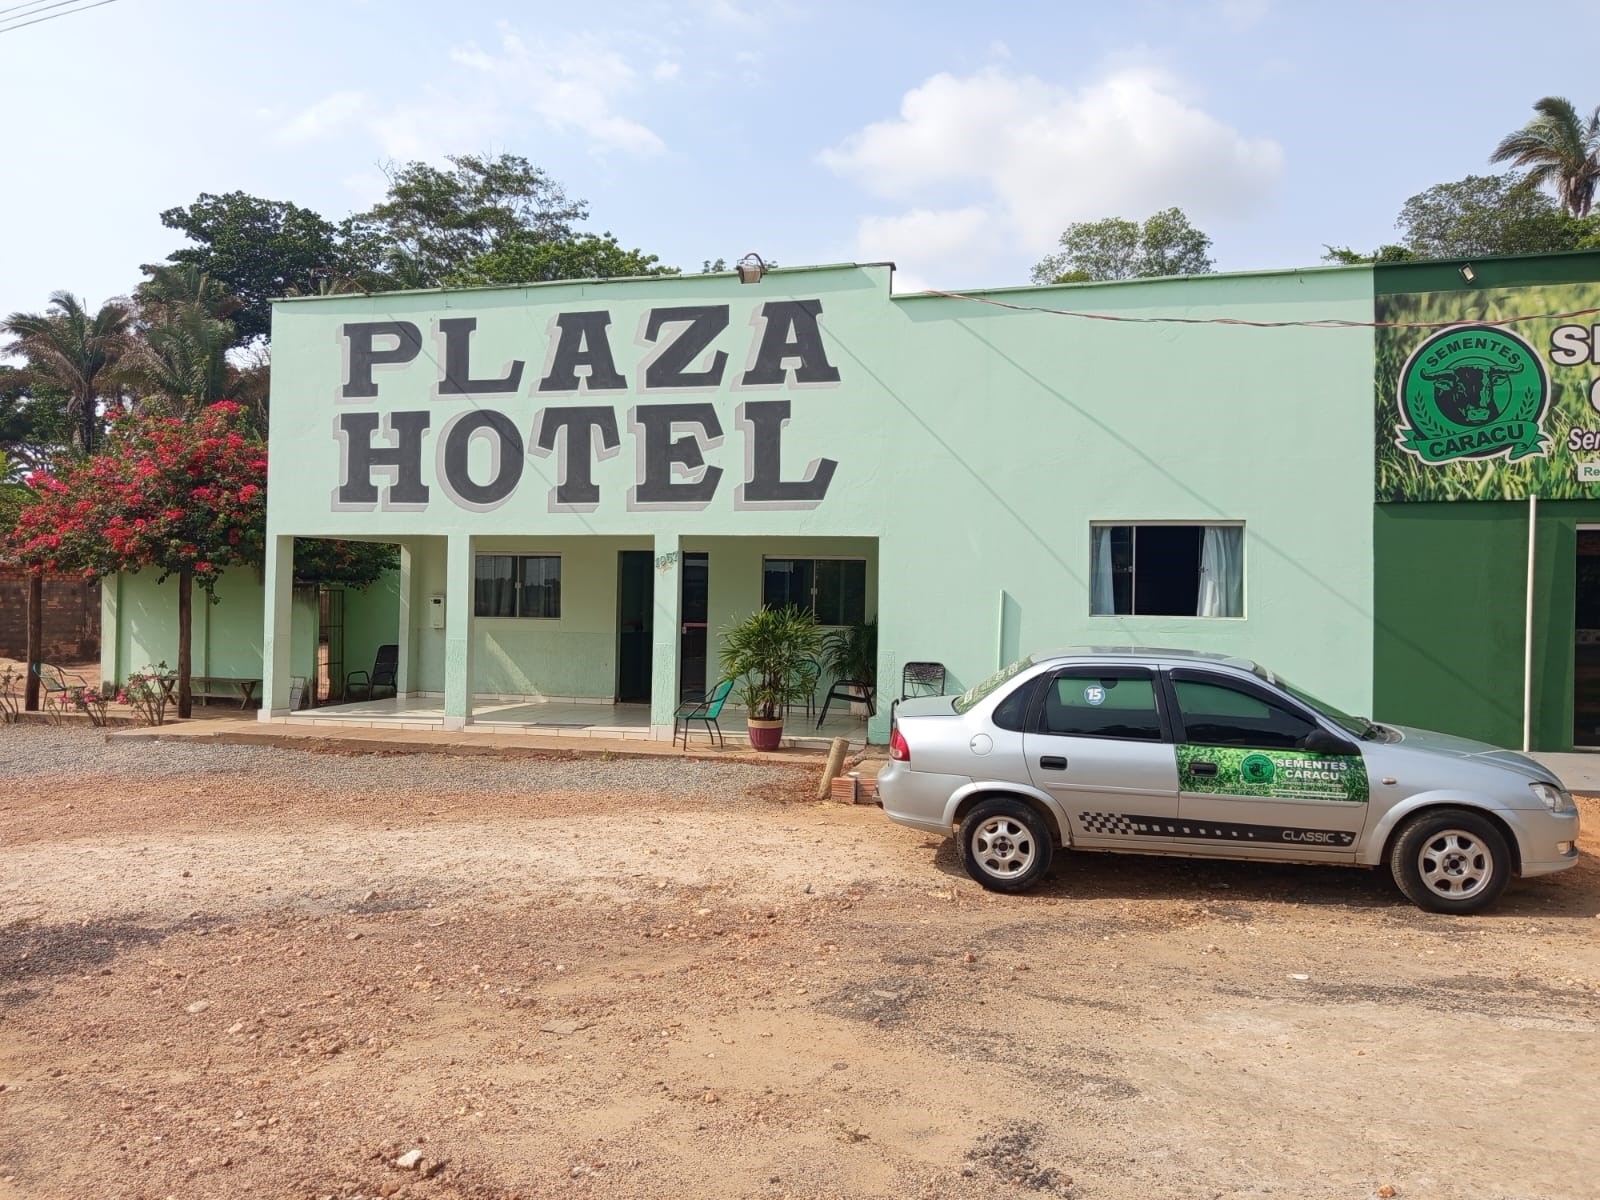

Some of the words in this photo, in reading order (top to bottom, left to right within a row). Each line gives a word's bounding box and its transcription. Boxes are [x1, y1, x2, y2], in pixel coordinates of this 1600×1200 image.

[336, 299, 841, 402] PLAZA
[1426, 337, 1521, 368] SEMENTES
[1549, 324, 1600, 366] S
[1428, 423, 1524, 458] CARACU
[331, 400, 839, 513] HOTEL
[1087, 688, 1102, 701] 15
[1276, 758, 1348, 771] SEMENTES
[1285, 769, 1340, 781] CARACU
[1282, 830, 1336, 843] CLASSIC
